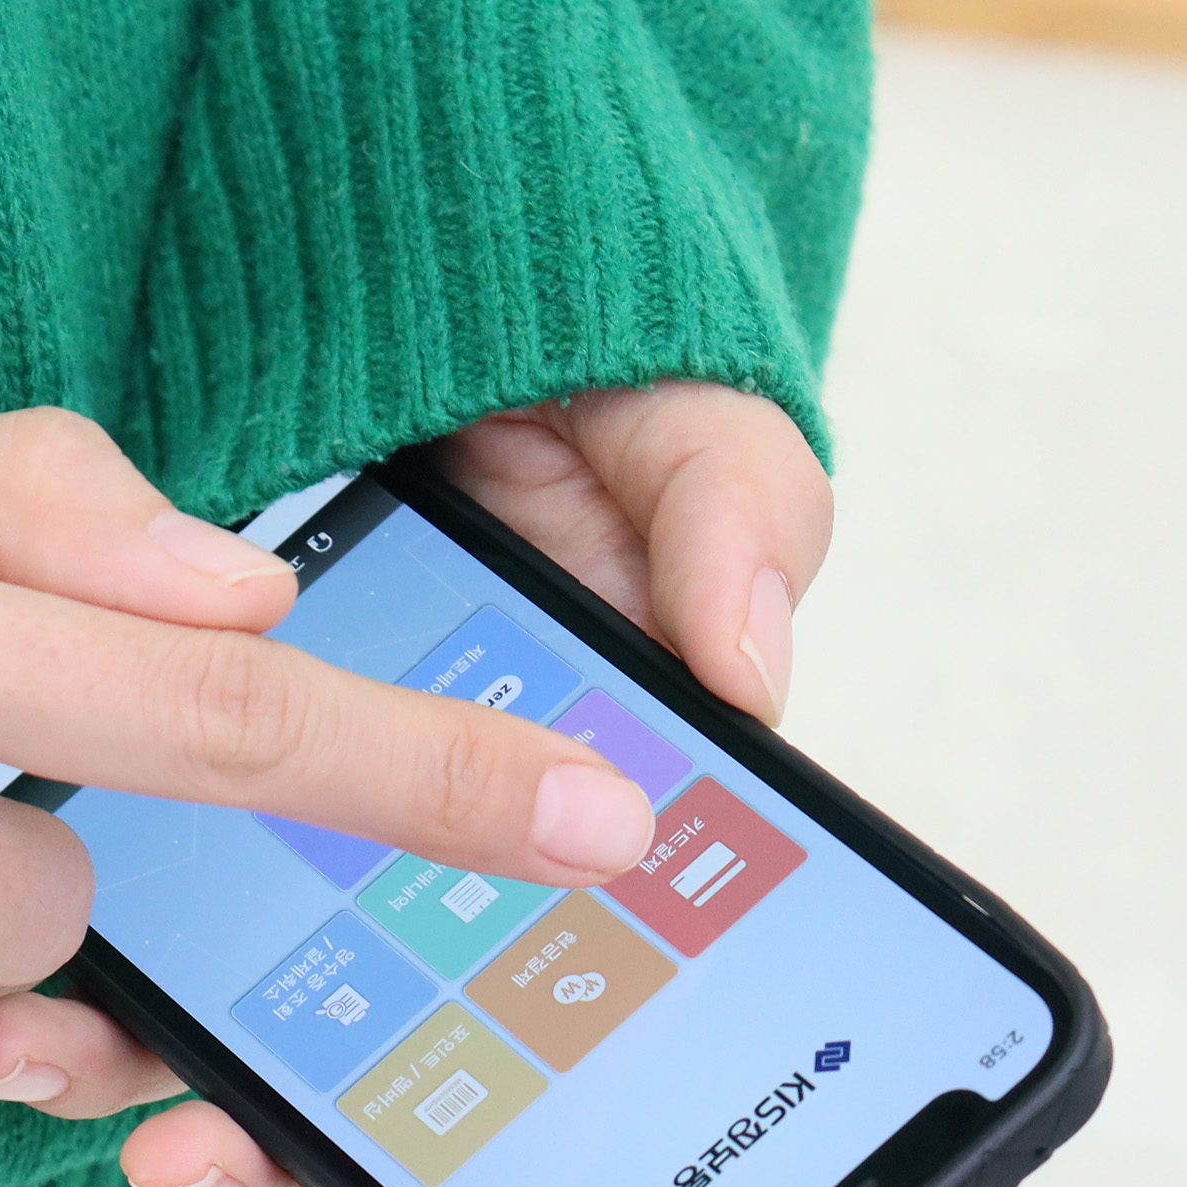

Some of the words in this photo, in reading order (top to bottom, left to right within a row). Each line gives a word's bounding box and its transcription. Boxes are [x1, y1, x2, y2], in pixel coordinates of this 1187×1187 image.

[487, 683, 512, 707] zer
[639, 817, 705, 874] 카드결제
[262, 947, 327, 1000] 결제취소
[307, 949, 356, 991] 영수증
[511, 930, 577, 988] 현금결제
[273, 989, 308, 1021] 조회
[419, 1024, 470, 1069] 포인트
[979, 1030, 1024, 1069] 2:58
[363, 1076, 413, 1120] 멤버십
